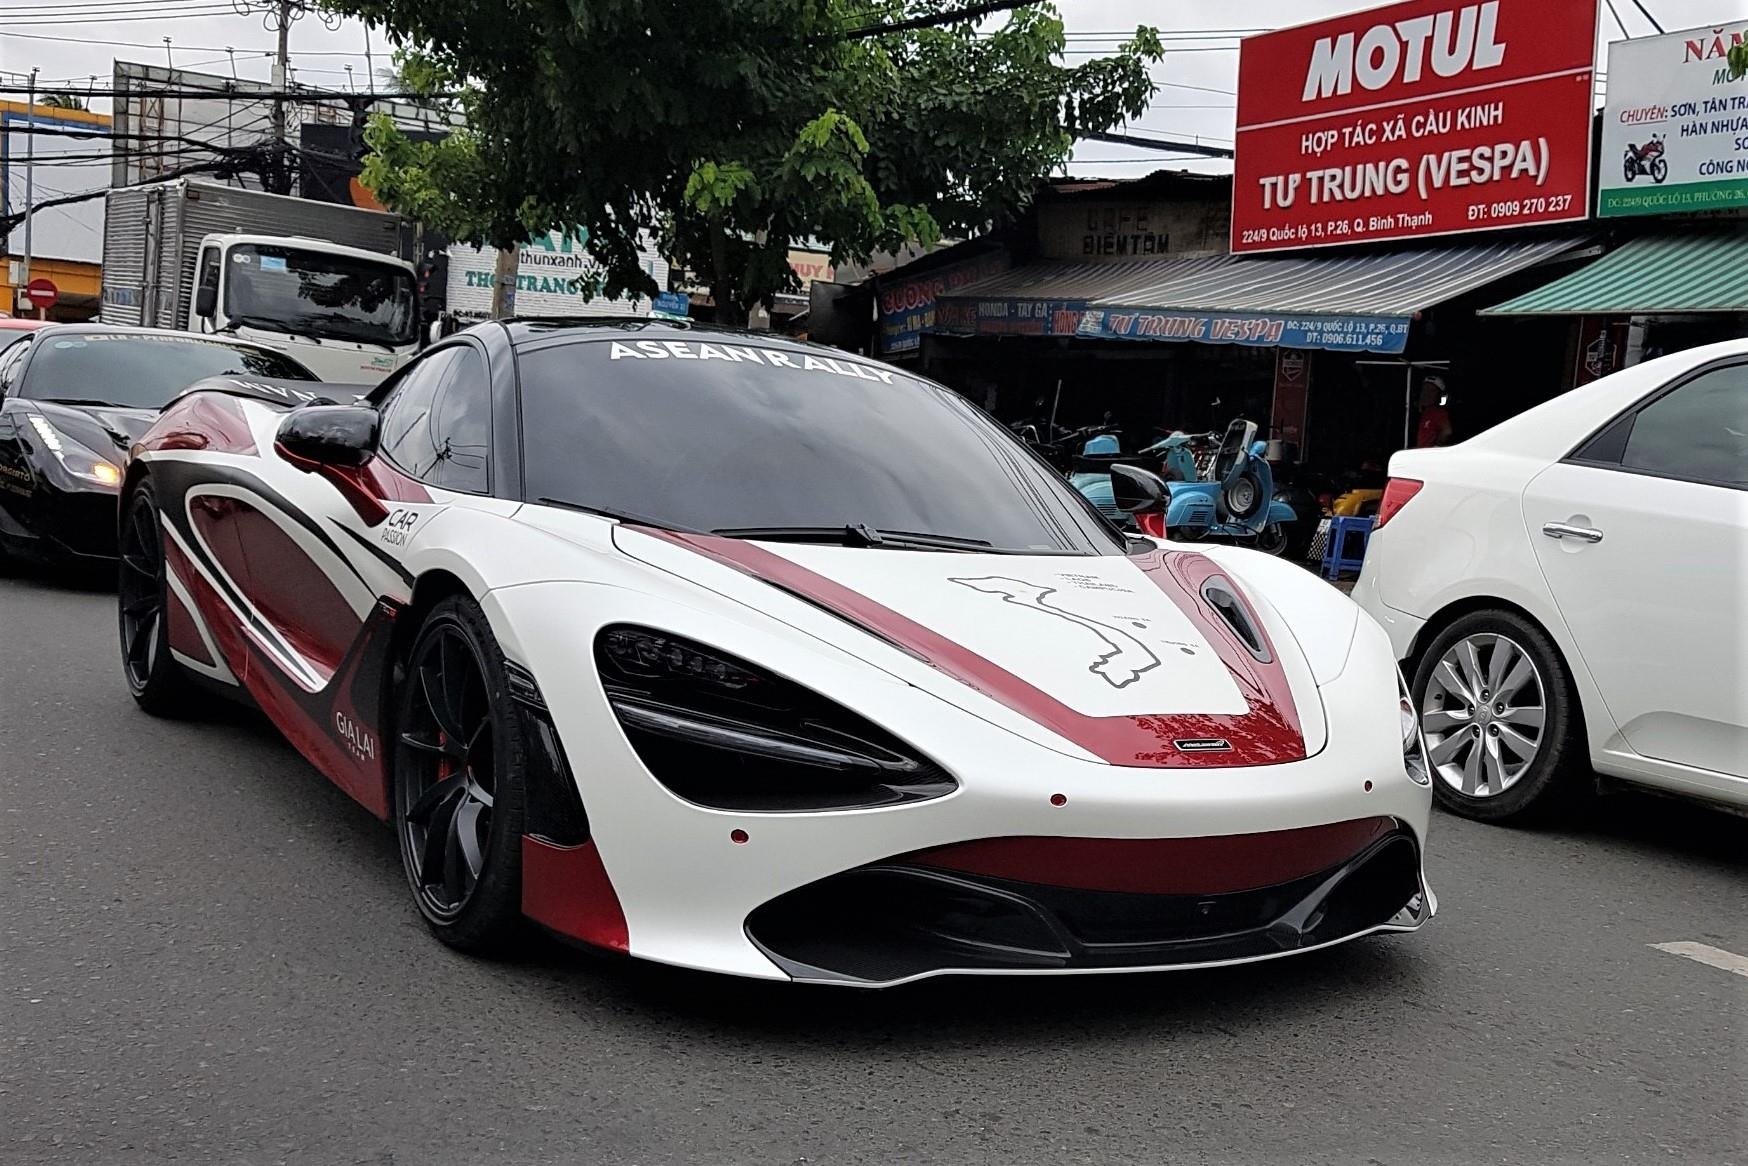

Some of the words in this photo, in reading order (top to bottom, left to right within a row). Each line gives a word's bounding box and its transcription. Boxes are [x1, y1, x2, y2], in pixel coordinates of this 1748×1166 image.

[1302, 0, 1506, 101] MOTUL
[1703, 98, 1728, 114] TÂN
[1301, 131, 1338, 156] HỢP
[1342, 121, 1376, 147] TÁC
[1382, 116, 1406, 142] XÃ
[1456, 102, 1503, 130] KINH
[1681, 117, 1707, 137] HÀN
[1259, 173, 1301, 209] TƯ
[1306, 159, 1410, 203] TRUNG
[1417, 138, 1550, 199] (VESPA)
[1468, 203, 1488, 220] ĐT:
[1491, 200, 1520, 218] 0909
[1523, 197, 1545, 215] 270
[1549, 194, 1572, 212] 237
[1242, 230, 1267, 243] 224/9
[1269, 223, 1295, 241] Quốc
[1298, 224, 1308, 240] lộ
[1311, 223, 1324, 237] 13,
[1327, 221, 1351, 235] P.26,
[1354, 218, 1366, 232] Q.
[1397, 211, 1432, 230] Thạnh
[520, 251, 598, 269] thunxanh.v
[1137, 315, 1208, 338] TRUNG
[1210, 317, 1285, 342] VESPA
[610, 341, 765, 366] ASEAN
[759, 349, 894, 385] RALLY
[389, 509, 419, 531] CAR
